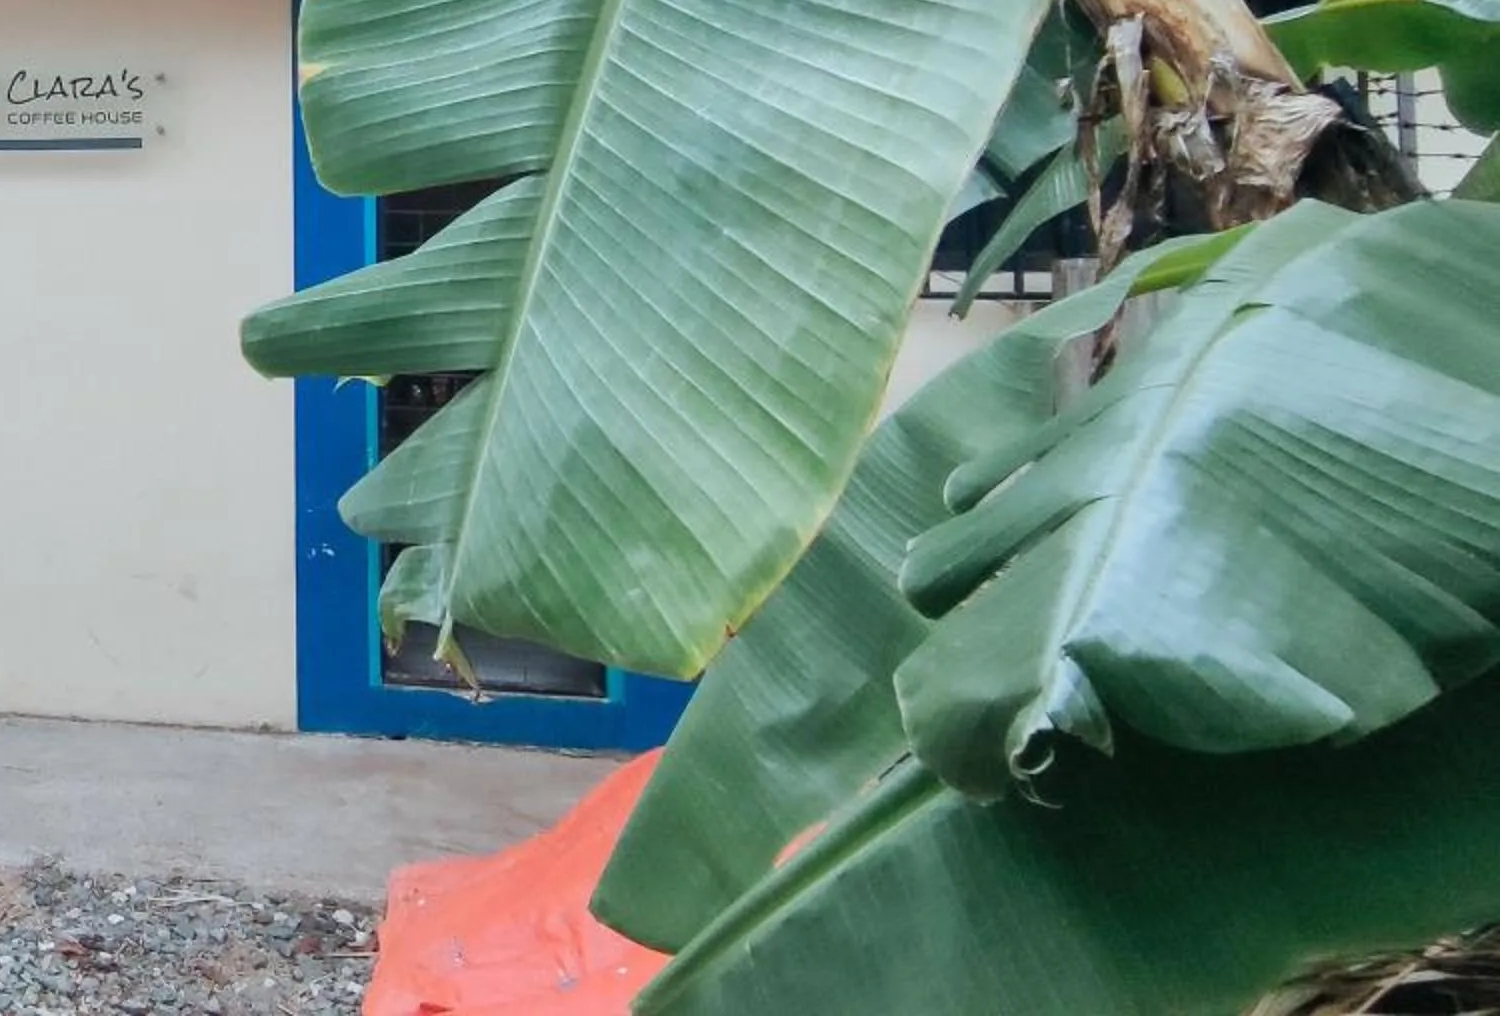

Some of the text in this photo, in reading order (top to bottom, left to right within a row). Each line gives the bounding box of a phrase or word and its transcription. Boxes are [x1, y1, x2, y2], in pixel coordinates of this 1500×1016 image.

[7, 69, 143, 105] CLARA'S
[7, 111, 143, 125] COFFEE HOUSE
